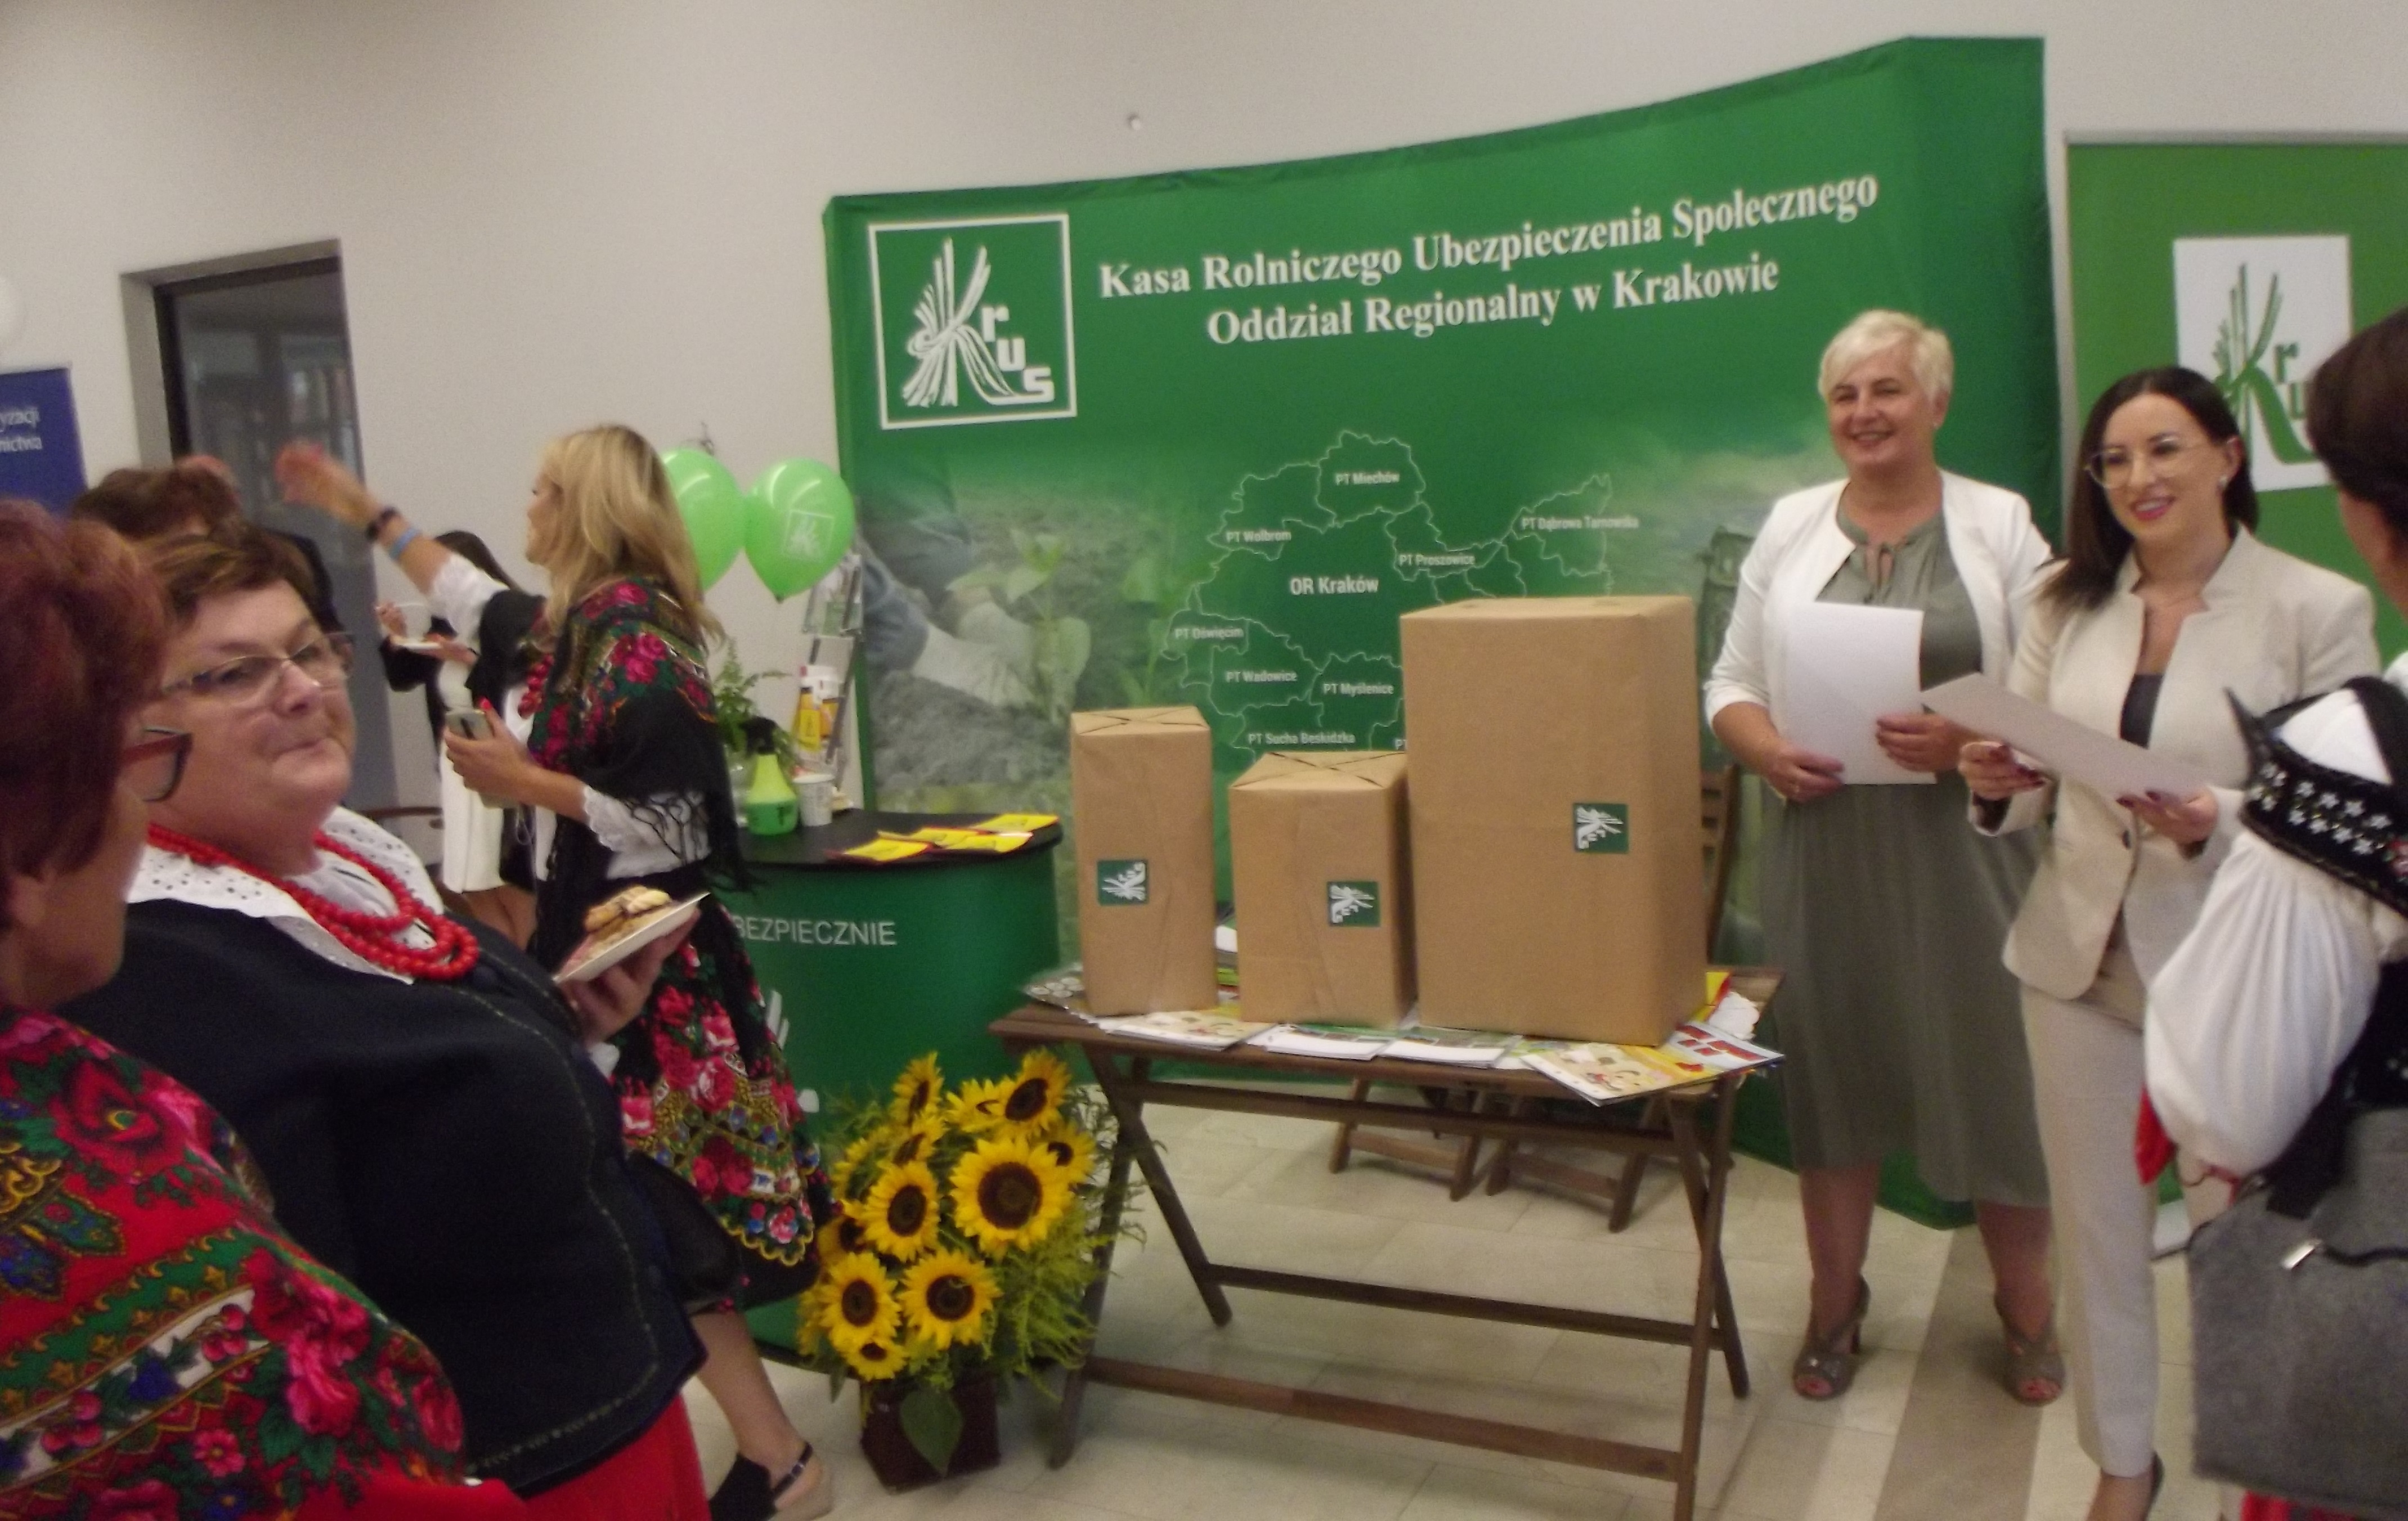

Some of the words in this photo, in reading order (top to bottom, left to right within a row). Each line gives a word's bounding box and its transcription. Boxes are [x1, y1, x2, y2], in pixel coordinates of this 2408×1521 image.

[1100, 263, 1191, 298] Kasa
[1203, 249, 1402, 286] Rolniczego
[1414, 207, 1662, 272] Ubezpieczenia
[1673, 174, 1878, 246] Społecznego
[1208, 300, 1353, 344] Oddział
[1365, 284, 1561, 338] Regionalny
[1572, 284, 1601, 313] w
[1613, 251, 1779, 309] Krakowie
[1336, 474, 1350, 485] PT
[1522, 517, 1536, 530] PT
[1226, 532, 1240, 542] PT
[1243, 529, 1292, 541] Wolbrom
[1400, 554, 1413, 566] PT
[1416, 553, 1475, 565] Proszowice
[1290, 578, 1315, 595] OR
[1319, 575, 1379, 594] Kraków
[1174, 629, 1189, 639] PT
[1226, 672, 1241, 683] PT
[1243, 670, 1297, 682] Wadowice
[1324, 683, 1338, 695] PT
[1340, 681, 1394, 697] Myślenice
[1248, 733, 1262, 744] PT
[1265, 733, 1299, 744] Sucha
[1301, 732, 1356, 744] Beskidzka
[733, 915, 897, 945] BEZPIECZNIE
